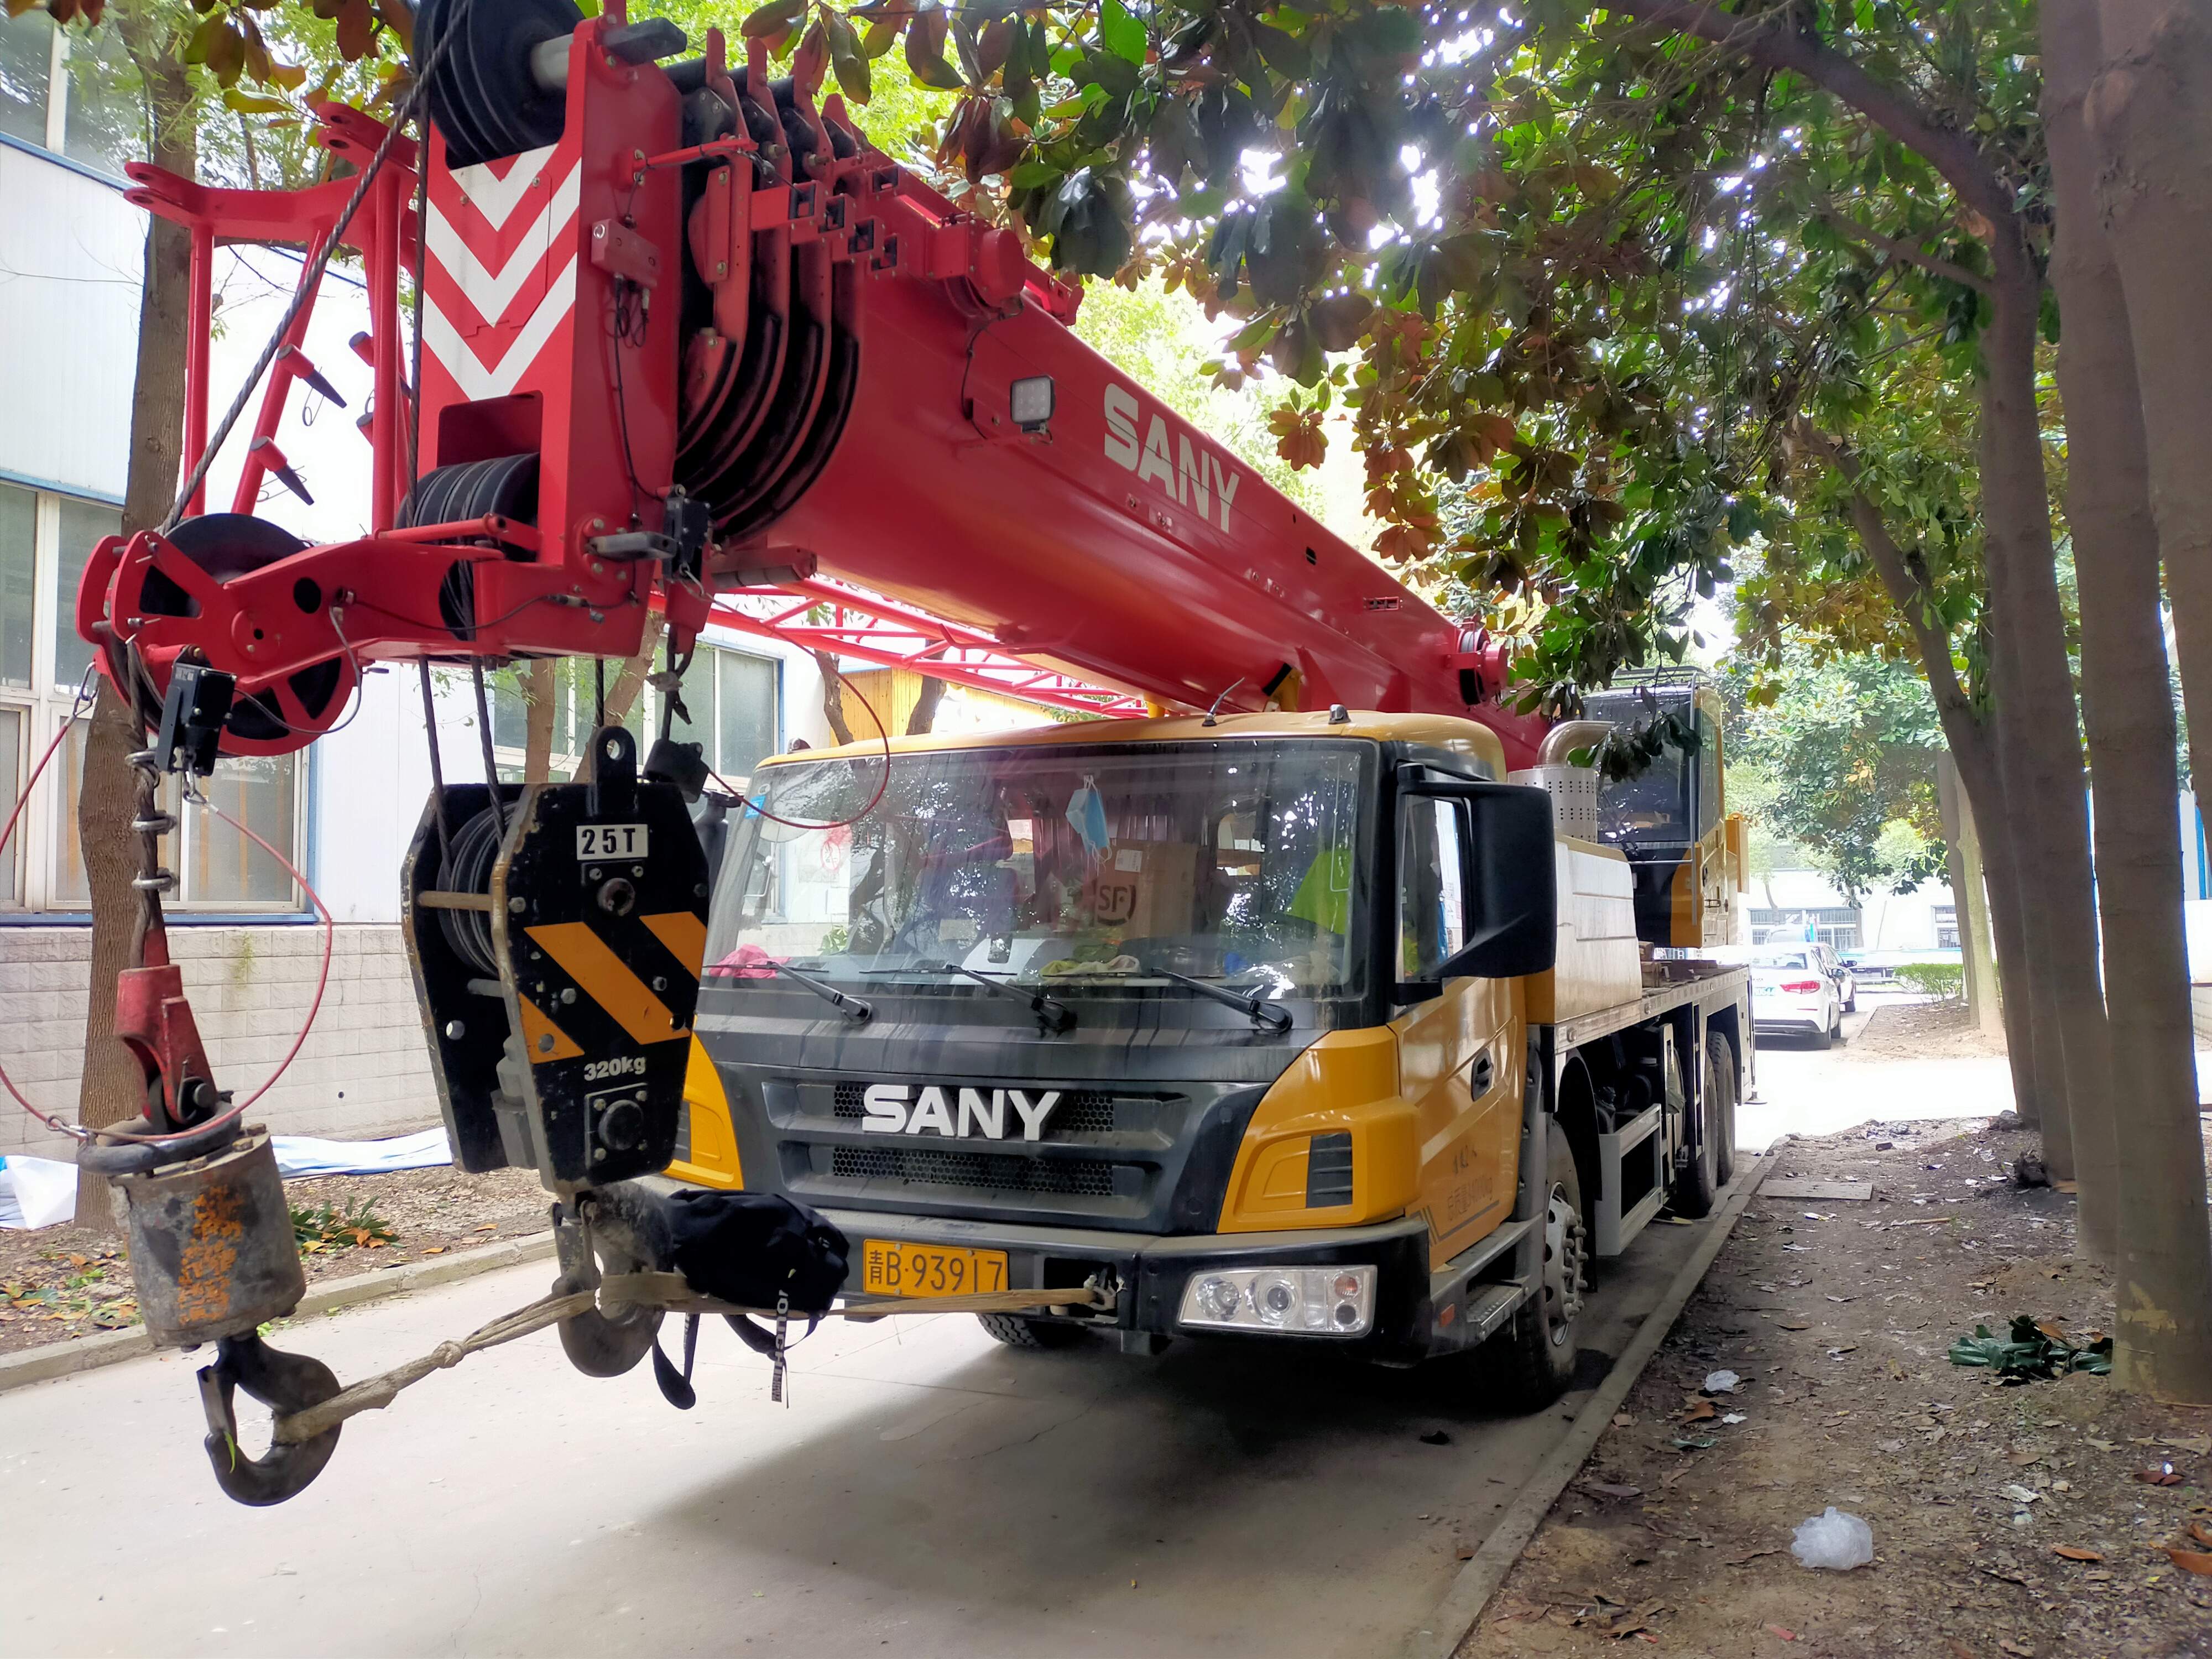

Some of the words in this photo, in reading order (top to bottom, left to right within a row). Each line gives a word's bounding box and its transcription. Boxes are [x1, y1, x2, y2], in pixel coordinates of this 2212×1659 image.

[1104, 383, 1240, 535] SANY
[581, 828, 635, 854] 25T
[1098, 884, 1128, 912] SF
[584, 1056, 646, 1081] 320kg
[862, 1084, 1060, 1141] SANY
